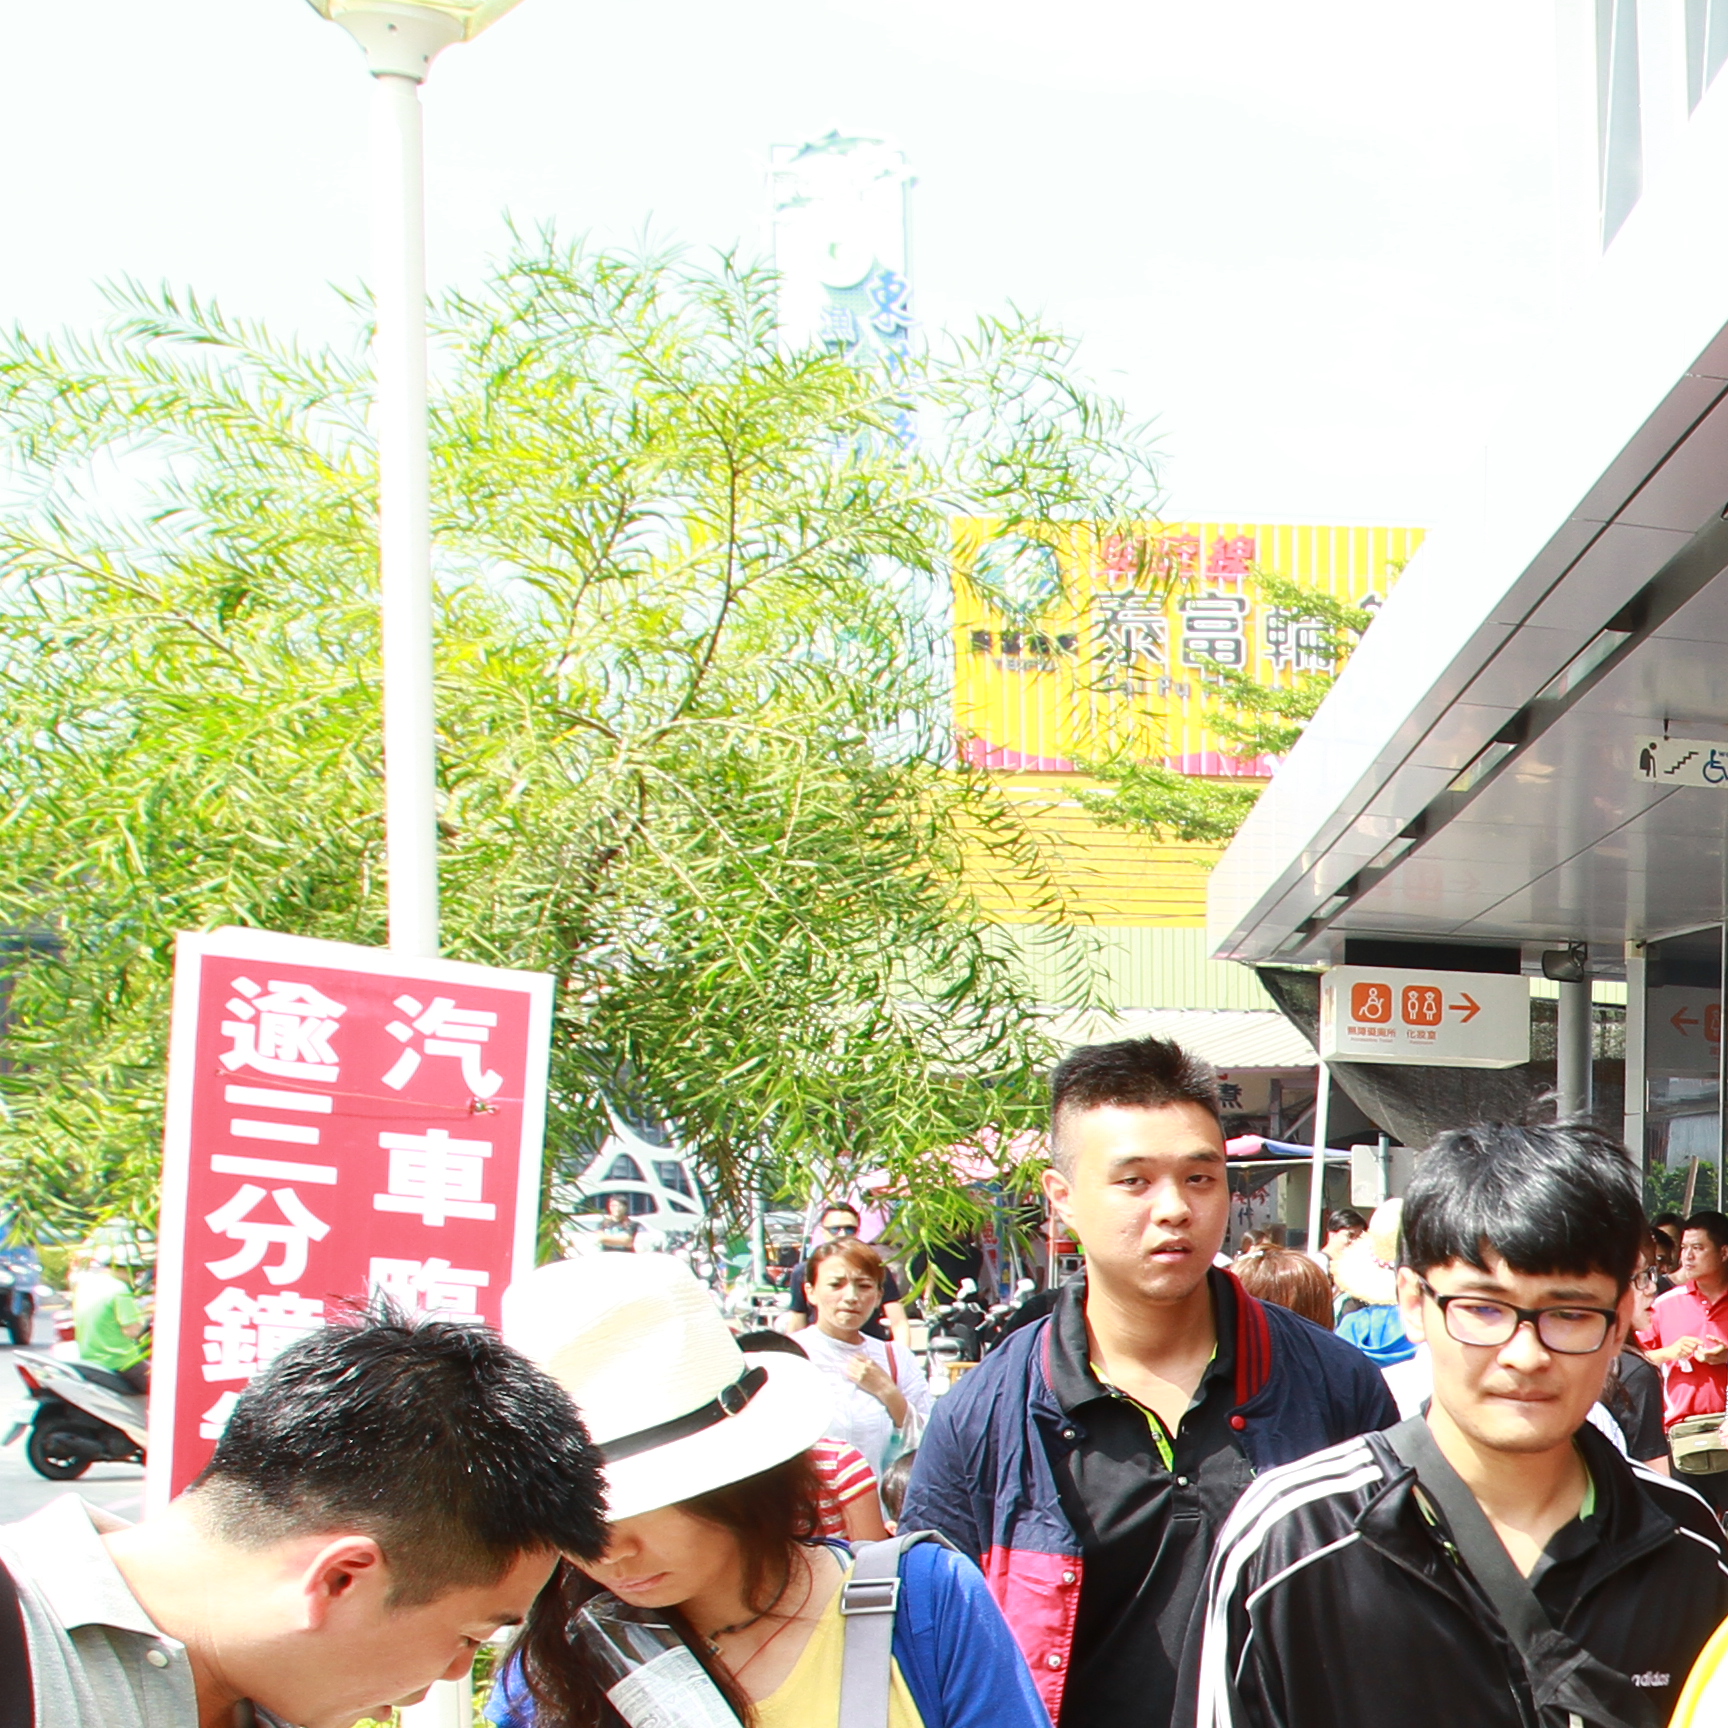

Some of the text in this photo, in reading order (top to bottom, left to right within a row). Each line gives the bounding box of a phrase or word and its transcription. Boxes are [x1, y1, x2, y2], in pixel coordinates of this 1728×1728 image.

[1094, 590, 1384, 674] 泰富輪
[199, 975, 349, 1440] 逾三分鐘
